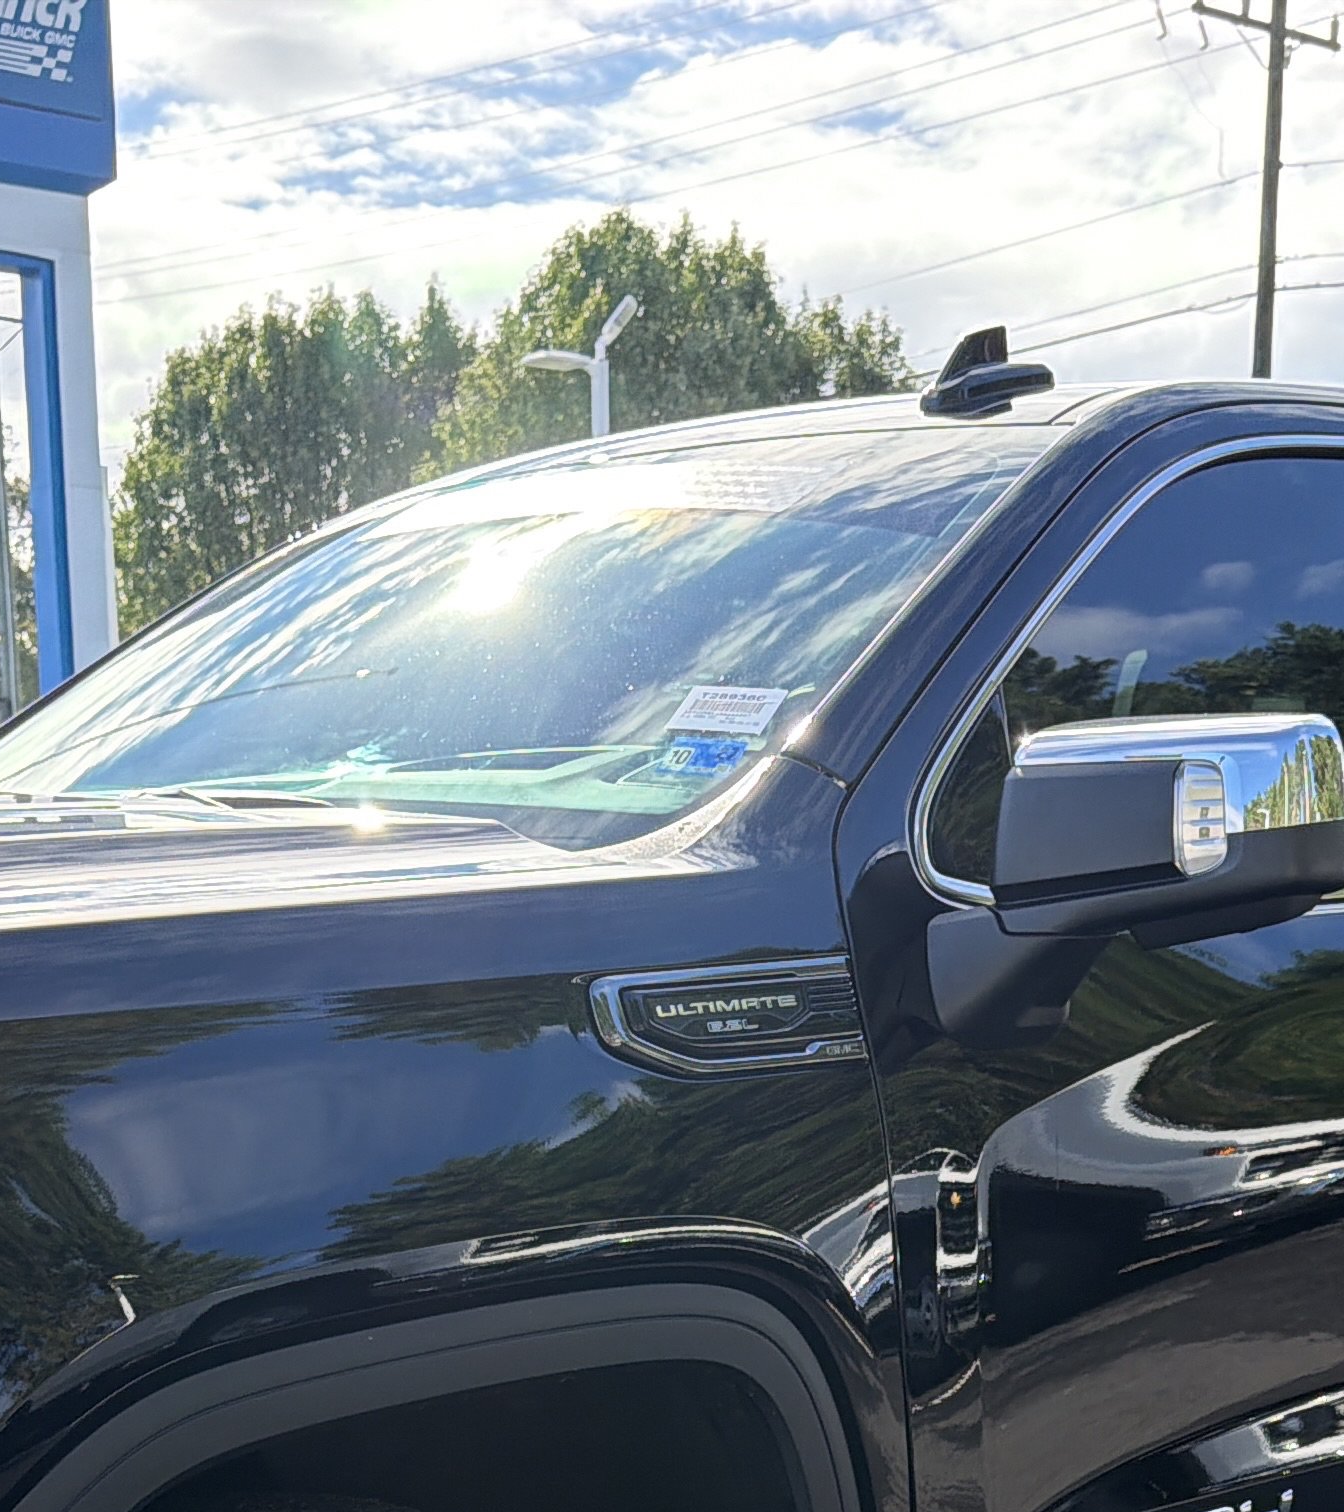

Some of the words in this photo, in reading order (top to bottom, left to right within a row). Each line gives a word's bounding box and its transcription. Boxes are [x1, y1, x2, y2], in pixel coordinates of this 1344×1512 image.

[0, 23, 43, 42] BUICK
[44, 31, 77, 48] GMC
[656, 994, 798, 1018] ULTIMATE
